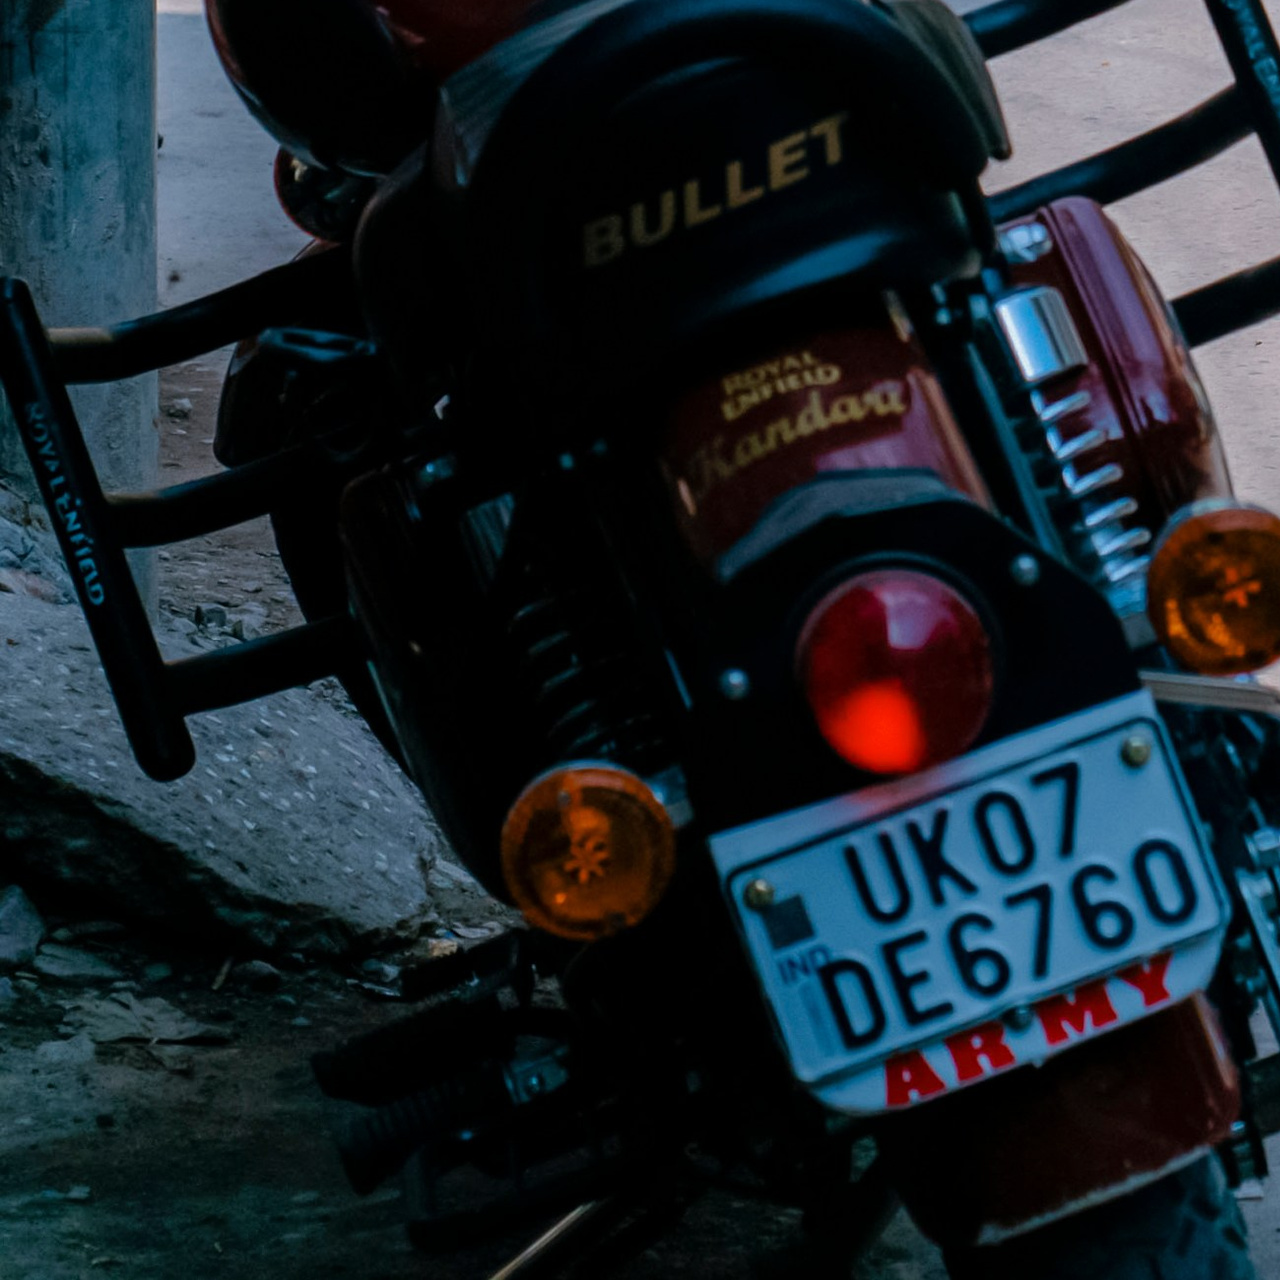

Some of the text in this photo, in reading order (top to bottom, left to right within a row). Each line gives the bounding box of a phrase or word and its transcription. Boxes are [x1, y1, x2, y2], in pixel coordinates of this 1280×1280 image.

[581, 111, 851, 269] BULLET
[720, 362, 841, 422] ENFIELD
[722, 349, 820, 397] ROYAL
[25, 400, 106, 607] ROYAL ENFIELD
[843, 760, 1081, 925] UK07
[818, 838, 1198, 1051] DE6760
[885, 949, 1174, 1107] ARMY
